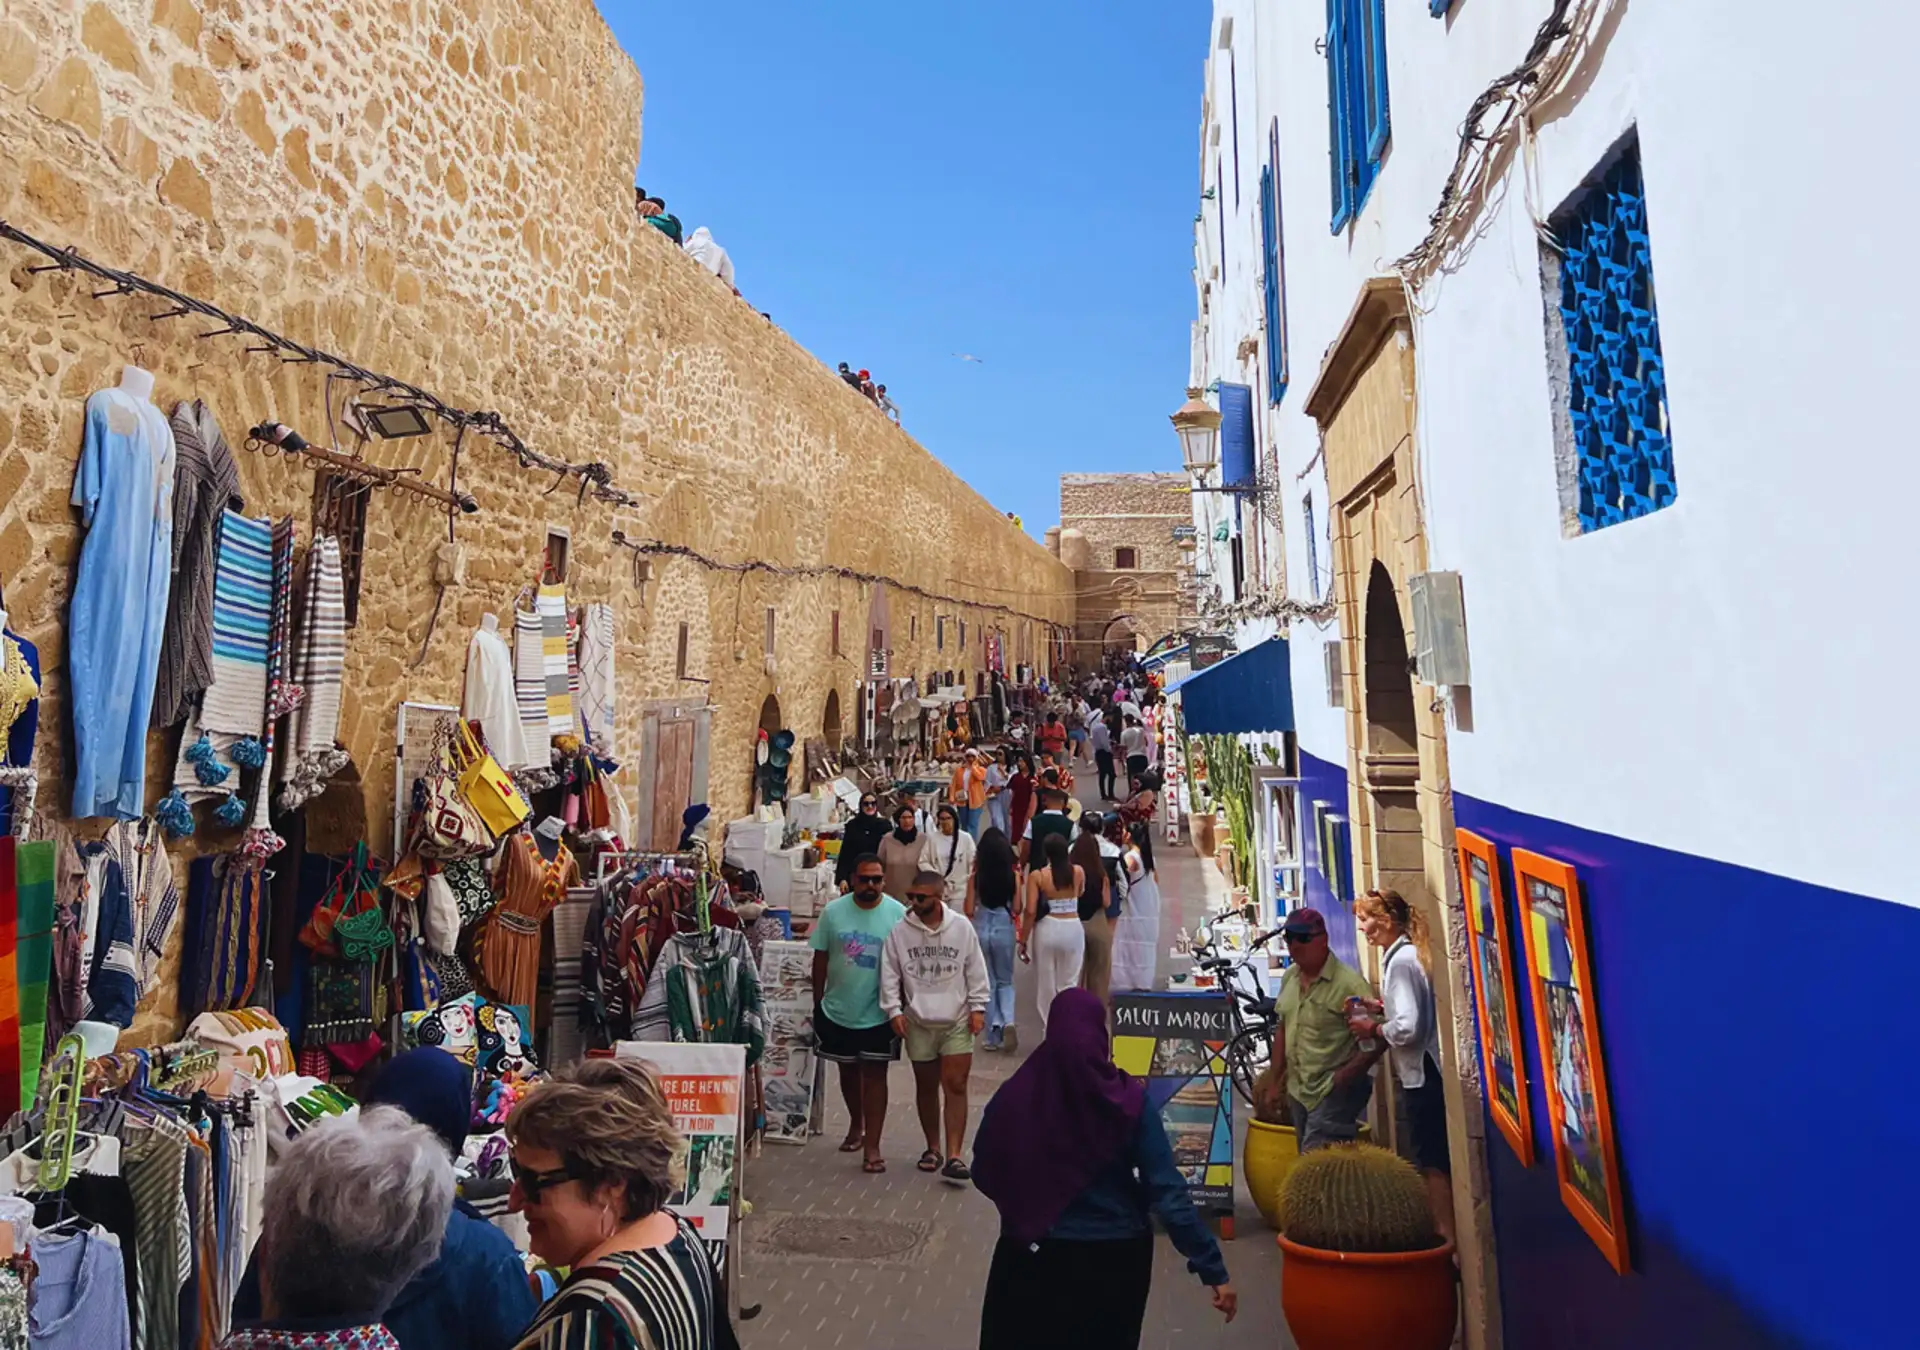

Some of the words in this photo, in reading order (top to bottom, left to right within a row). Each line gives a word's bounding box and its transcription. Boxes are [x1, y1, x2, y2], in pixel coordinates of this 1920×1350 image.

[1116, 1007, 1160, 1026] SALUT
[1167, 1011, 1225, 1029] MAROC!
[682, 1080, 696, 1094] DE
[669, 1098, 702, 1112] TUREL
[689, 1118, 714, 1131] NOIR
